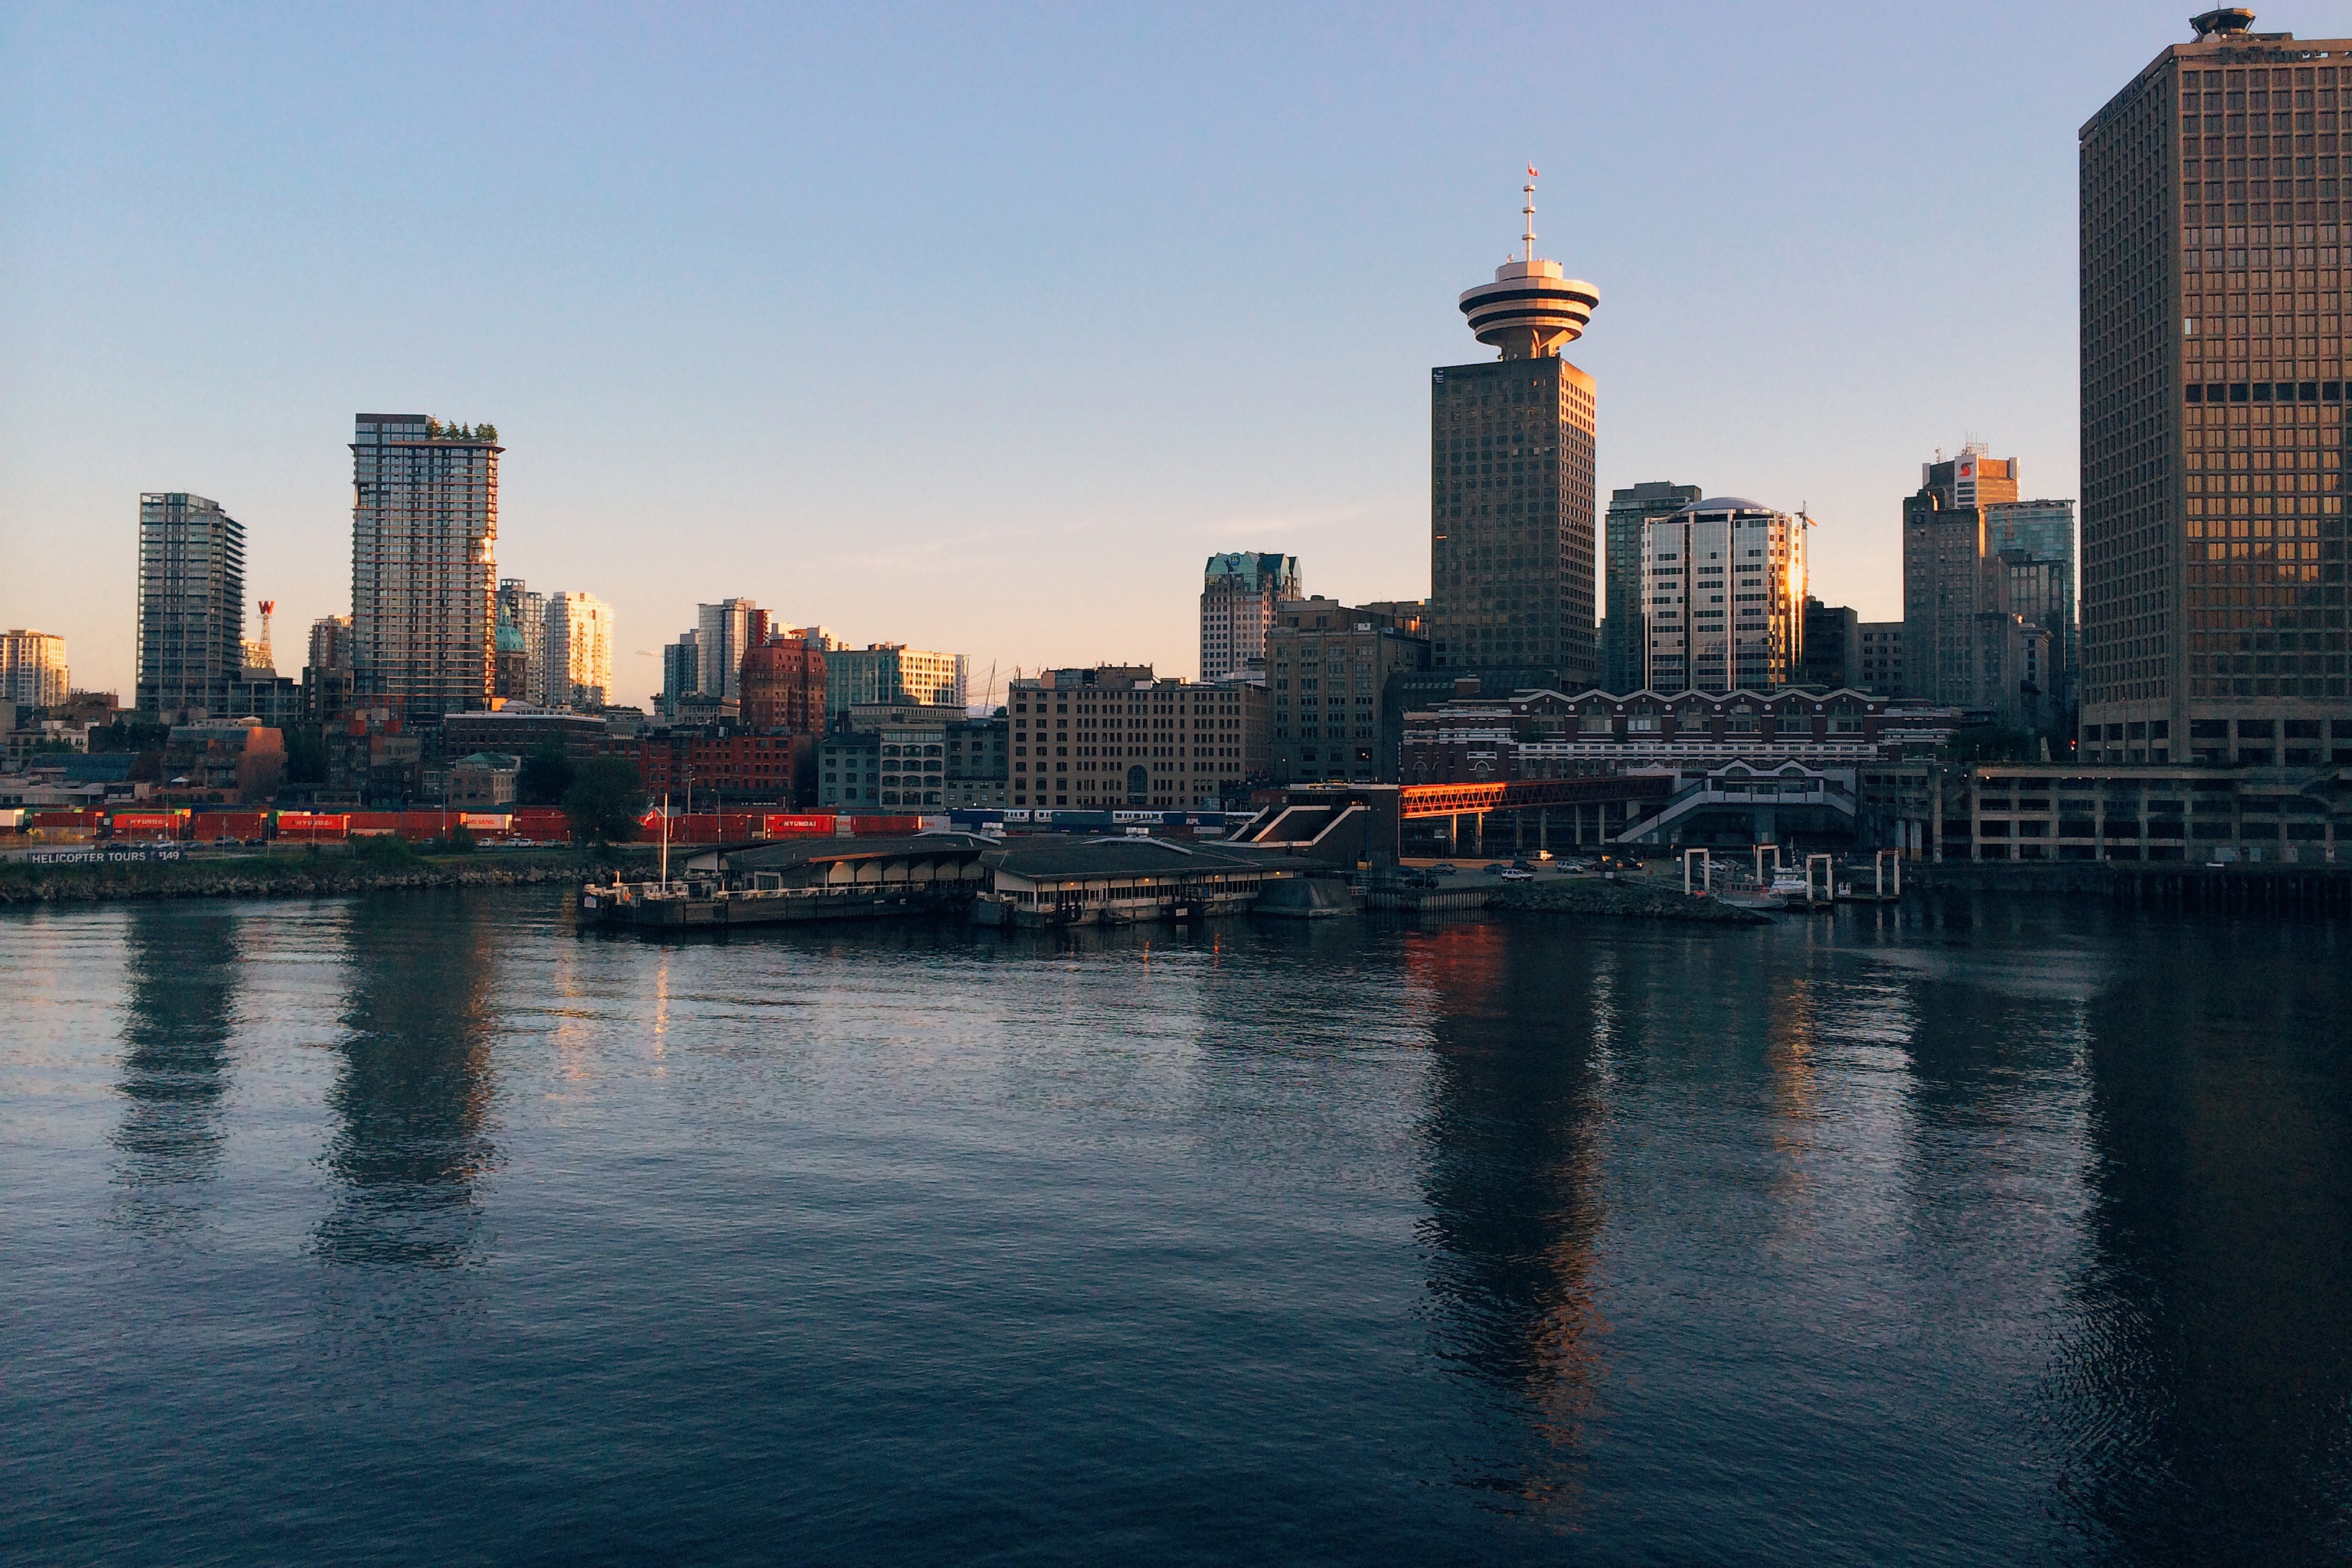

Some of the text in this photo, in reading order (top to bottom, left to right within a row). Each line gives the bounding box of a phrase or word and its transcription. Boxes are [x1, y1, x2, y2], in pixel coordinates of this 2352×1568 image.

[258, 600, 275, 614] W
[32, 851, 179, 864] HELICOPTER TOURS $149
